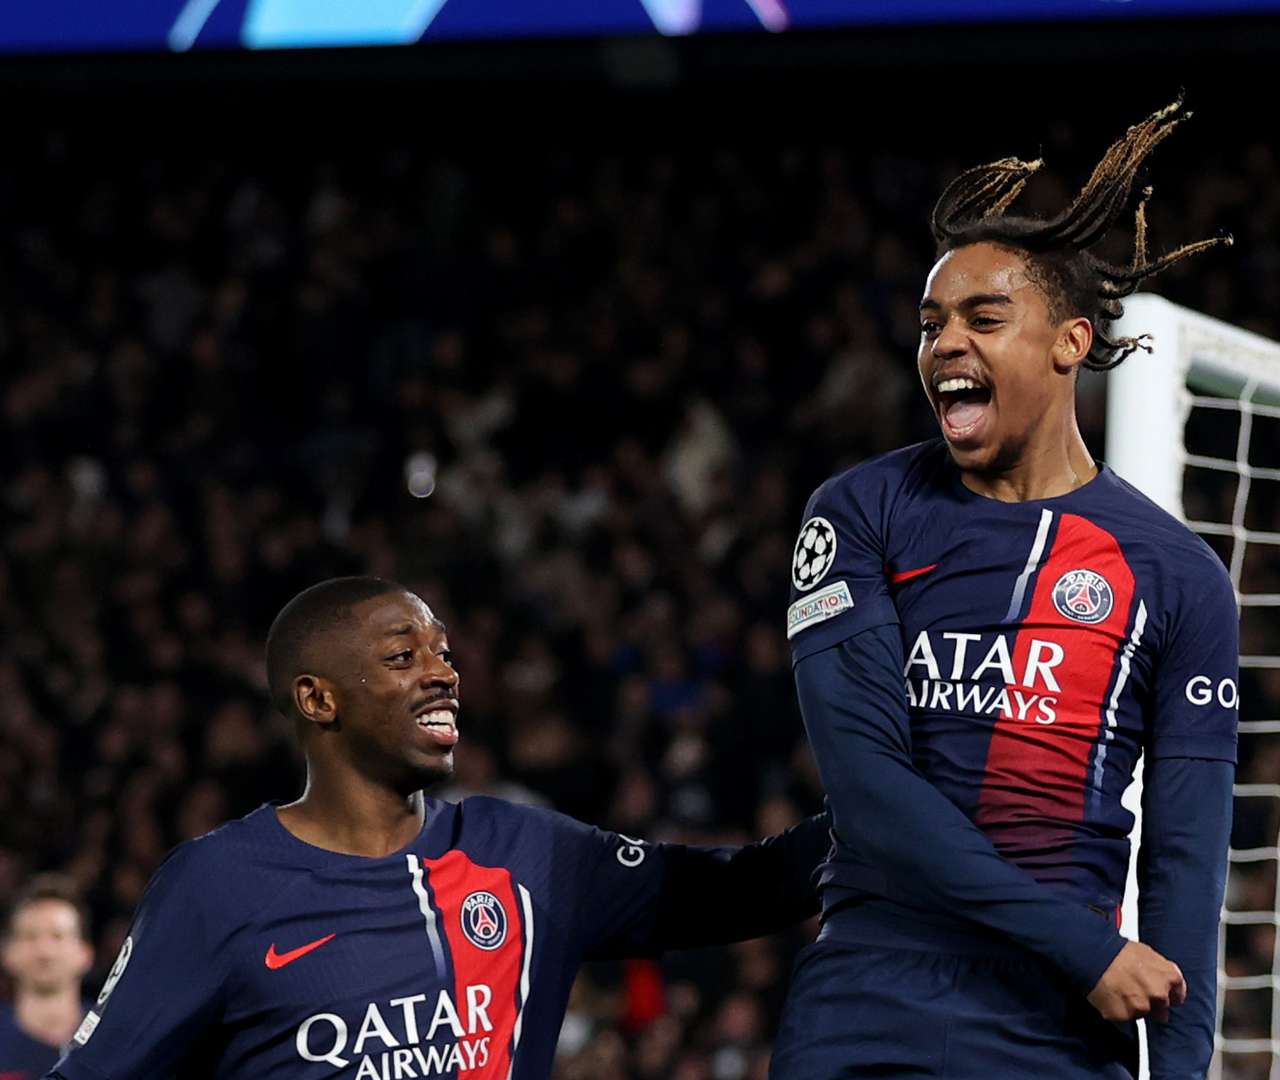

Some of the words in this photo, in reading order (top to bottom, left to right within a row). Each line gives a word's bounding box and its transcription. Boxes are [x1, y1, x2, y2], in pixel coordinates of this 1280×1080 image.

[1067, 572, 1106, 591] PARIS
[904, 630, 1063, 693] ATAR
[905, 678, 1058, 725] AIRWAYS
[1185, 675, 1240, 711] GO
[465, 895, 495, 911] PARIS
[296, 984, 494, 1068] QATAR
